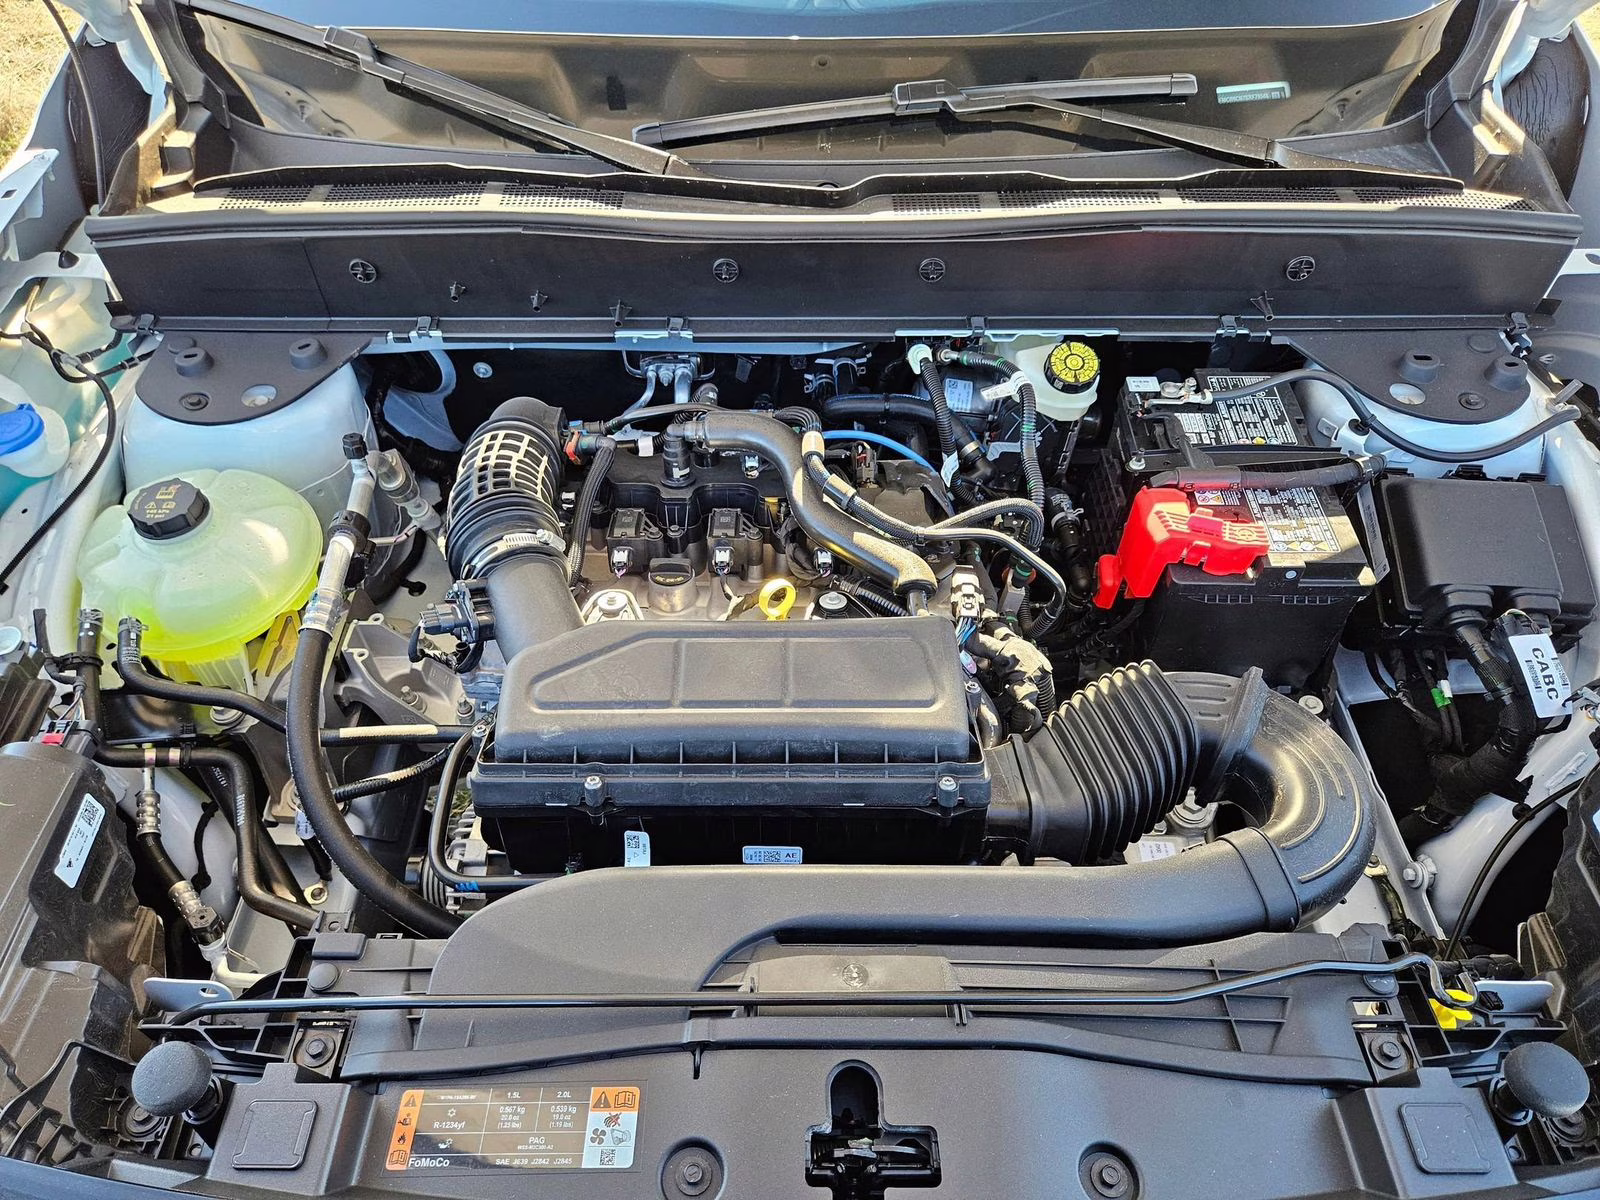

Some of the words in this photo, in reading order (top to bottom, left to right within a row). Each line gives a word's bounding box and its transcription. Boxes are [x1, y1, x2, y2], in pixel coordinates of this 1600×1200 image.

[1531, 647, 1559, 701] CABC
[507, 1091, 521, 1099] 1.5L
[517, 1106, 526, 1114] kg
[550, 1105, 567, 1113] 0.539
[568, 1105, 577, 1113] kg
[433, 1121, 466, 1129] R-1234yf
[528, 1136, 546, 1144] PAG
[408, 1157, 450, 1167] FoMoCo
